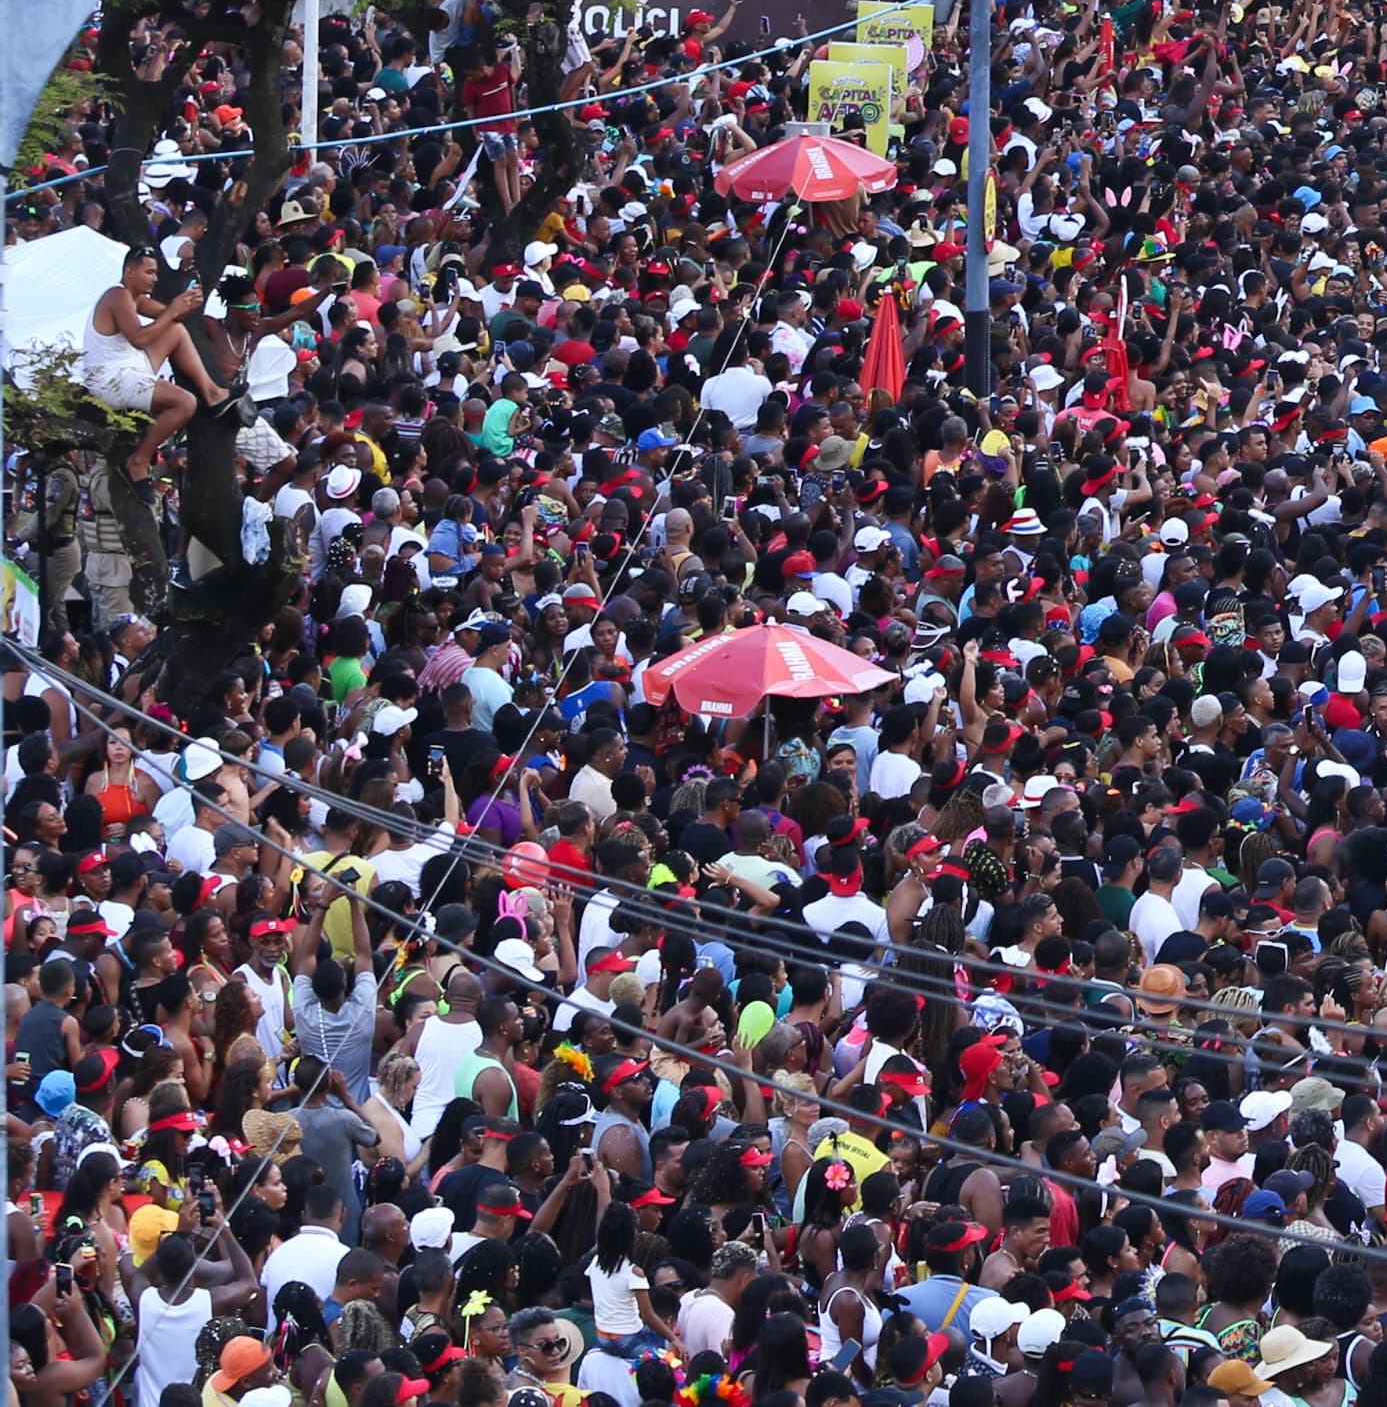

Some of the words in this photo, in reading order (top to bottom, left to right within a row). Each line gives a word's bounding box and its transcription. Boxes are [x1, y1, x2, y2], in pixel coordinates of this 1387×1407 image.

[818, 85, 881, 102] CAPITAL
[816, 102, 883, 125] AFRO
[805, 146, 834, 181] BRAHMA
[661, 634, 736, 677] BRAHMA
[700, 700, 734, 714] BRAHMA
